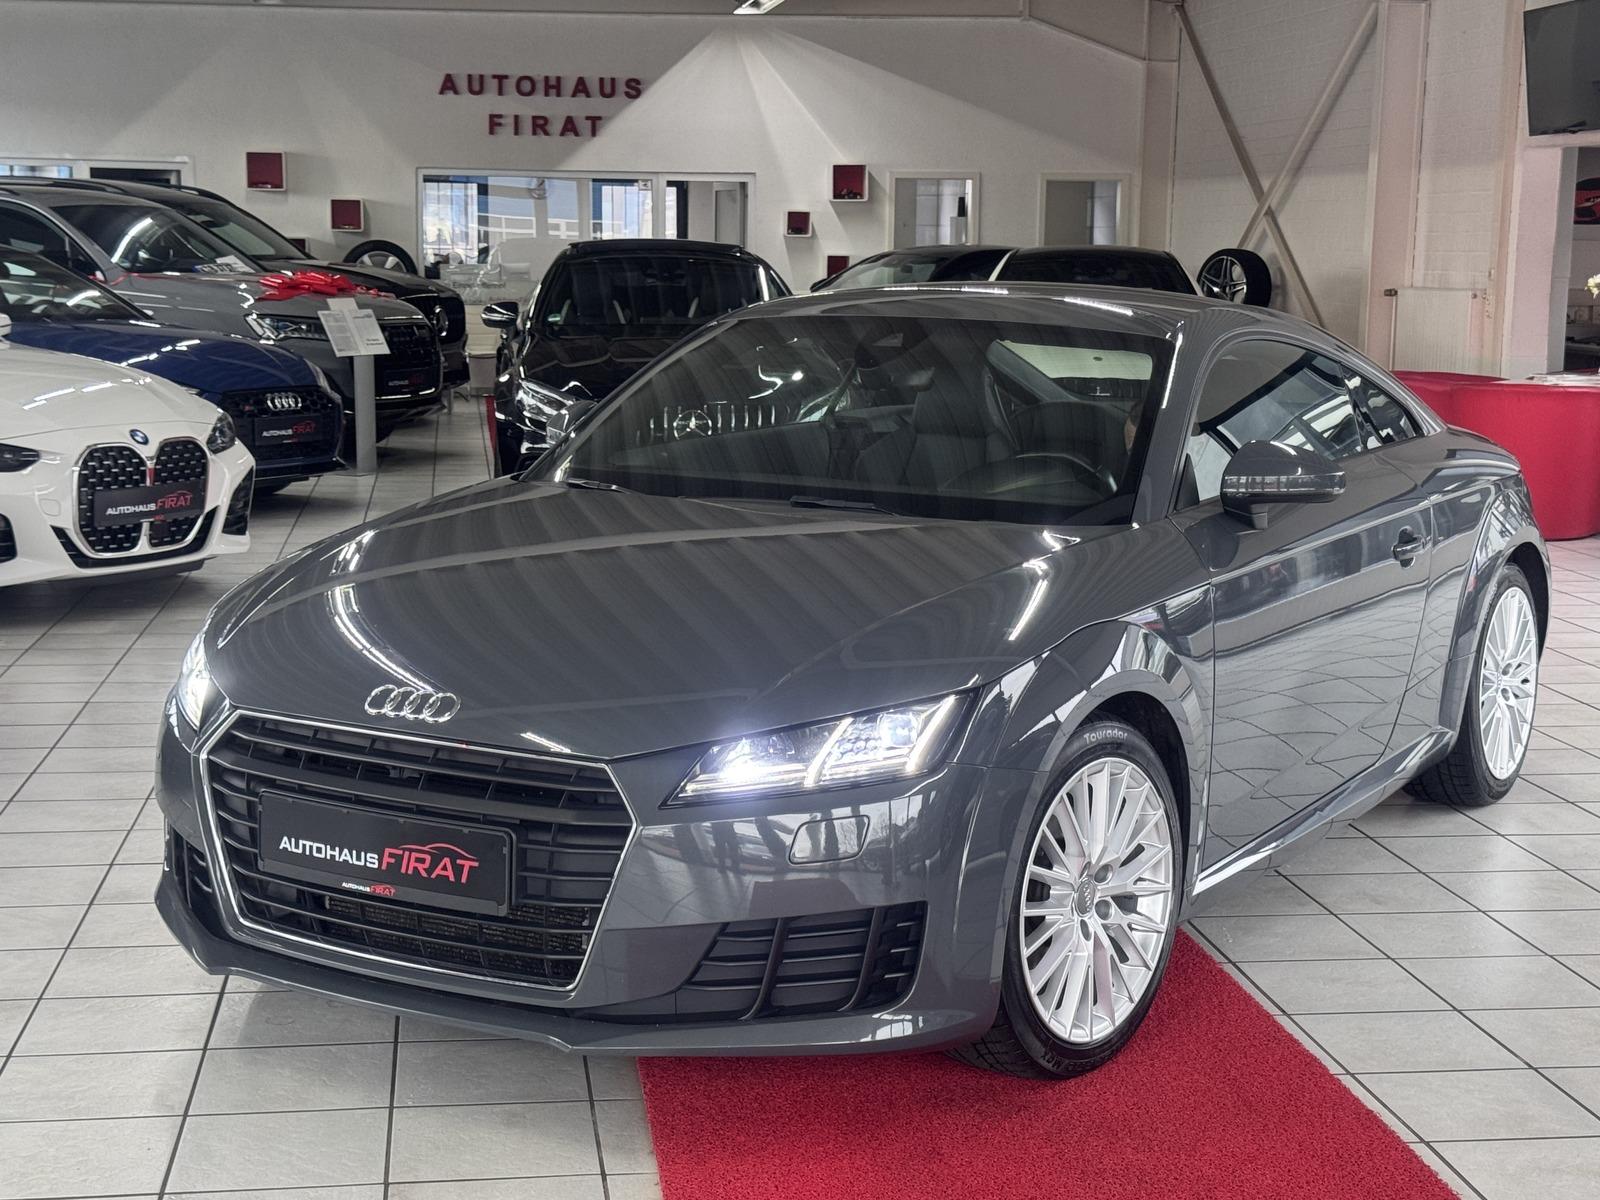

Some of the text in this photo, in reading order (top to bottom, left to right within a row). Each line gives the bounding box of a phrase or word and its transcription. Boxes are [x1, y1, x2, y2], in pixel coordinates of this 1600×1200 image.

[438, 73, 643, 100] AUTOHAUS
[488, 113, 603, 138] FIRAT
[105, 495, 193, 516] AUTOHAUS FIRAT
[1083, 728, 1128, 745] Touradar
[279, 836, 480, 884] AUTOHAUS FIRAT
